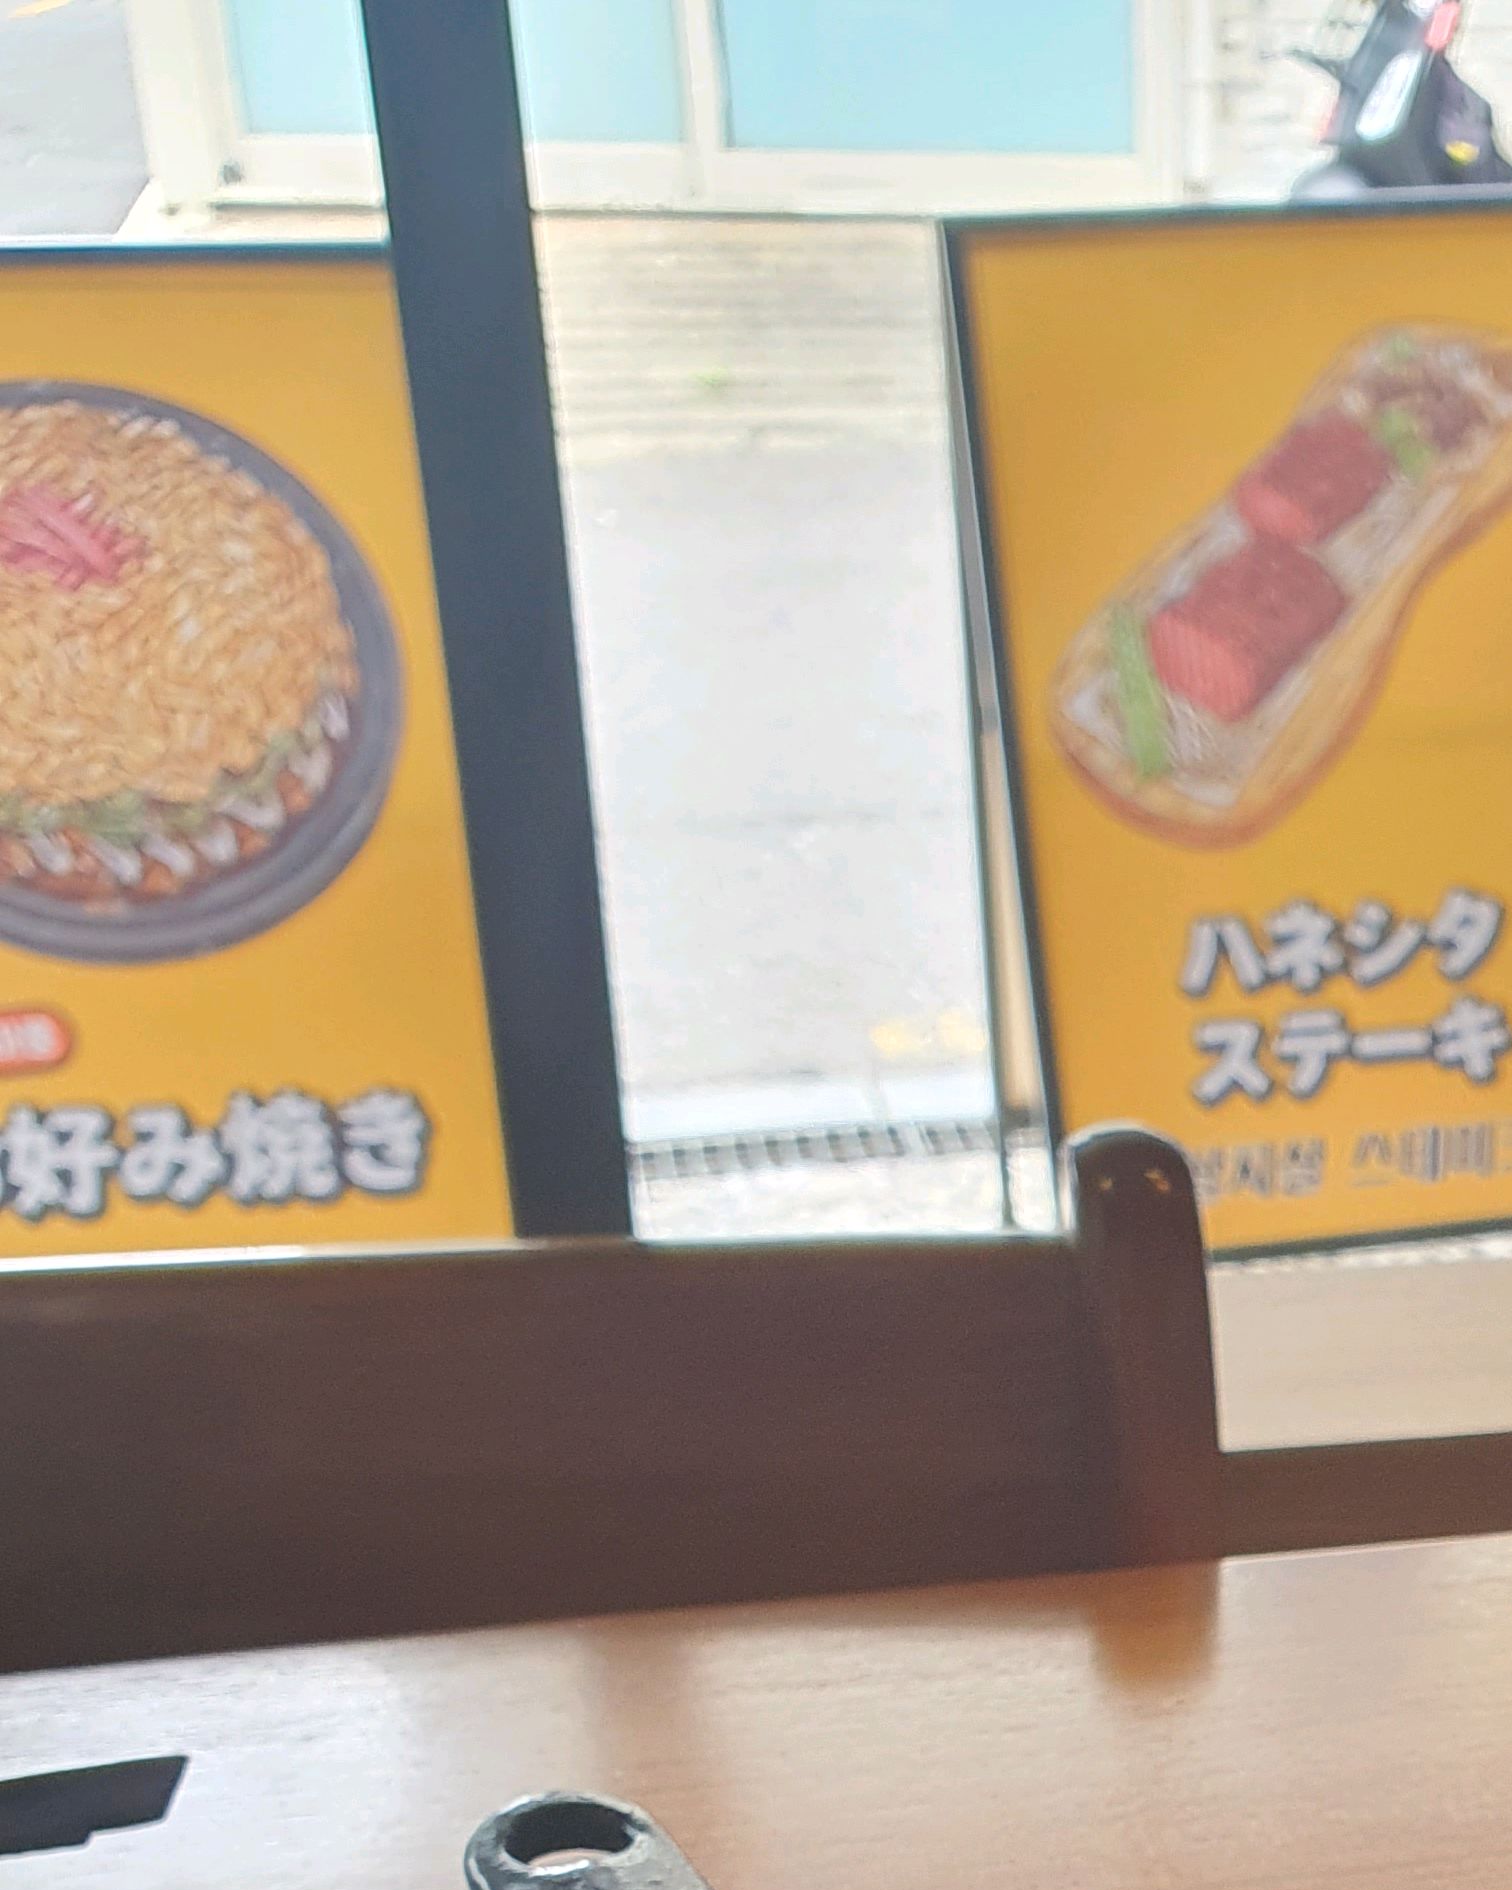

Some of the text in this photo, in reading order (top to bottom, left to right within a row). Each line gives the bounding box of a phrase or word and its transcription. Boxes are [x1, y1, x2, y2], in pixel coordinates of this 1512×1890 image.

[1179, 885, 1506, 996] ハネシタ
[0, 1089, 428, 1220] 好み焼き
